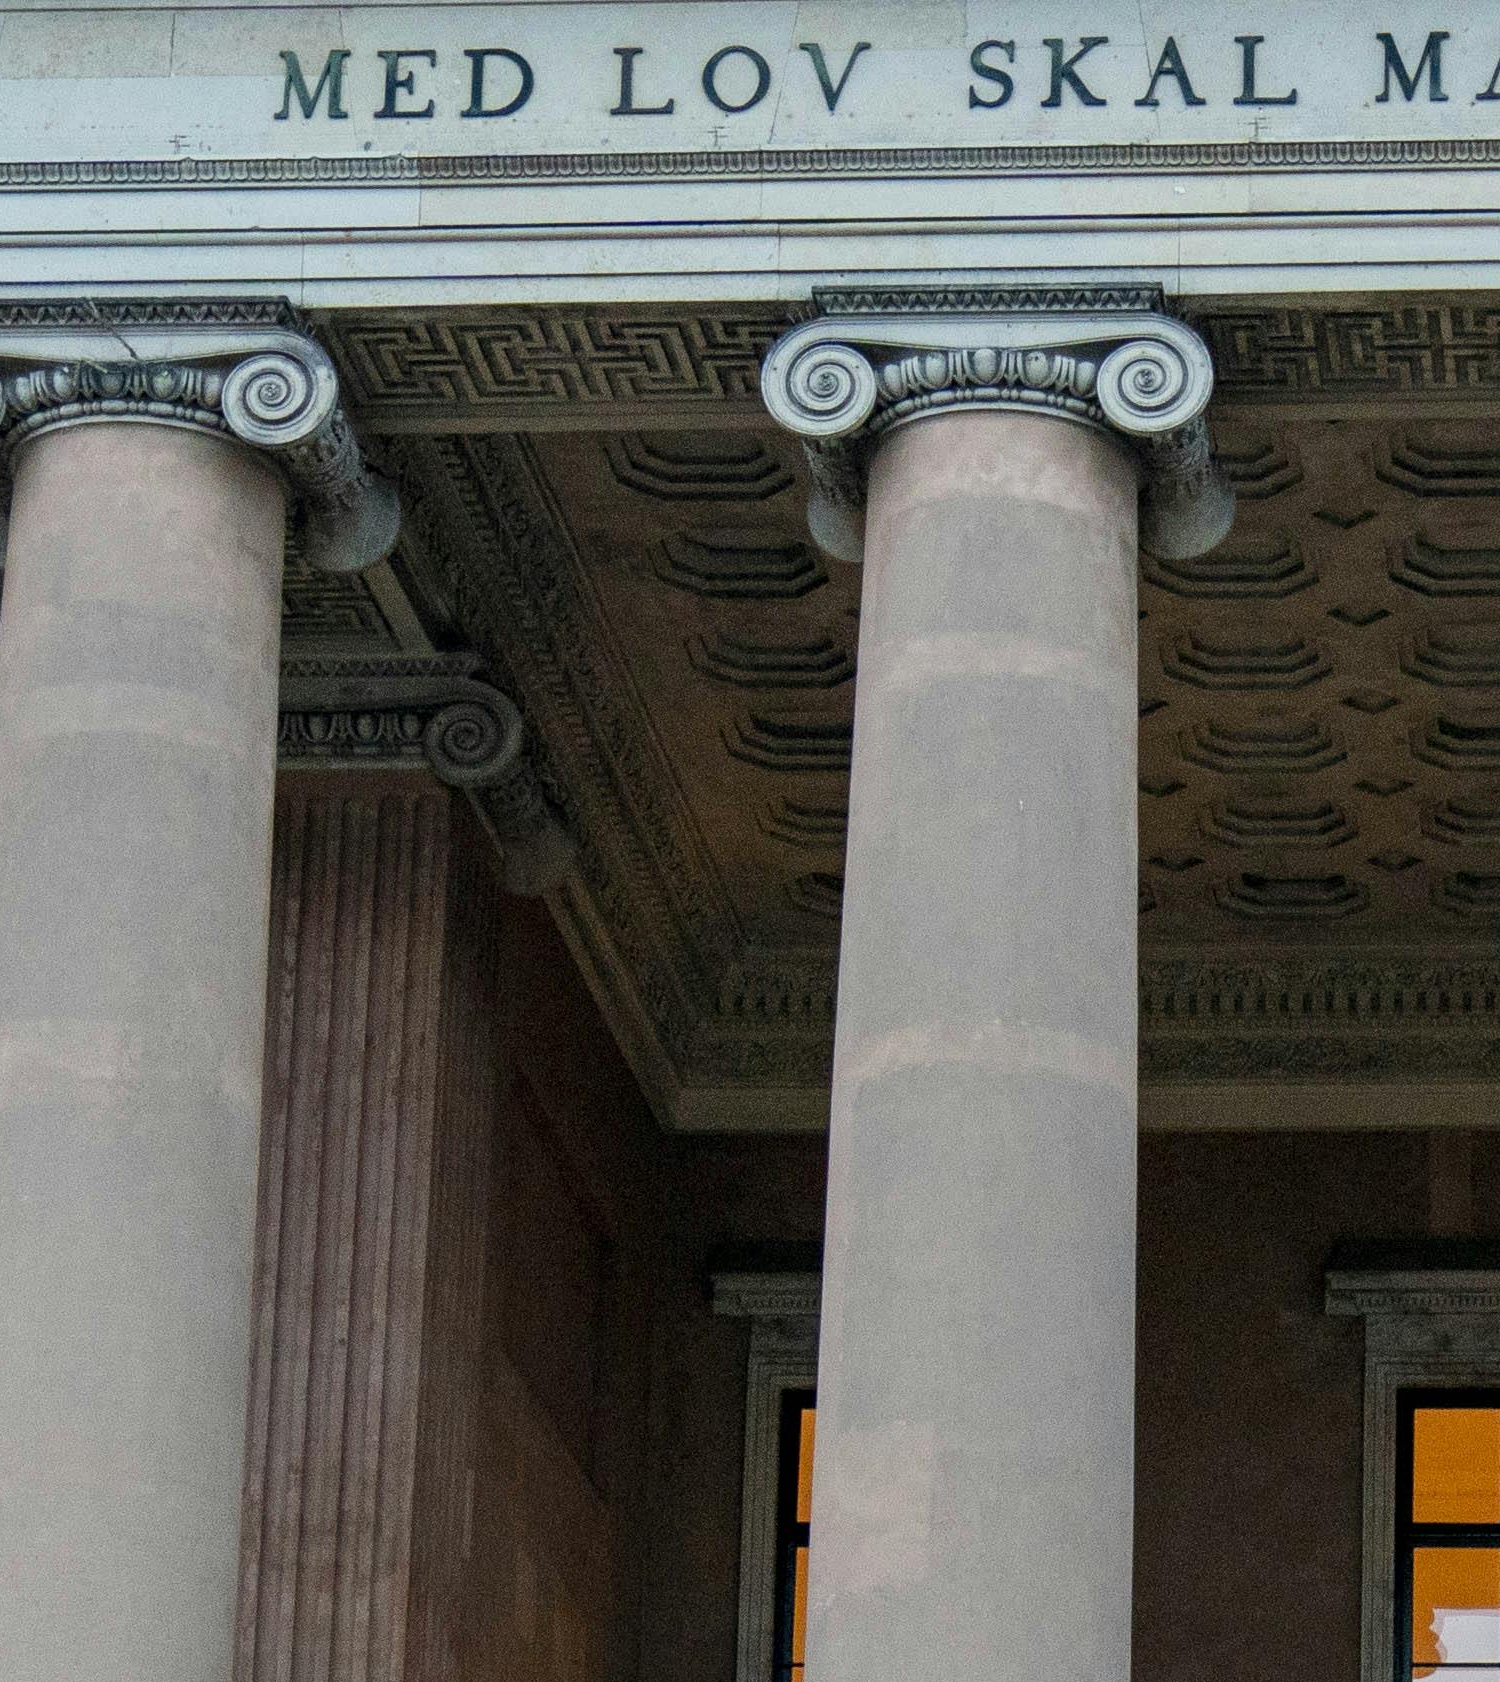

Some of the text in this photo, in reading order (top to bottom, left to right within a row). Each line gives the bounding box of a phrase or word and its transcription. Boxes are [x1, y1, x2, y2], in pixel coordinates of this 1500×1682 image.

[274, 46, 534, 121] MED
[610, 42, 871, 115] LOV
[968, 35, 1298, 110] SKAL
